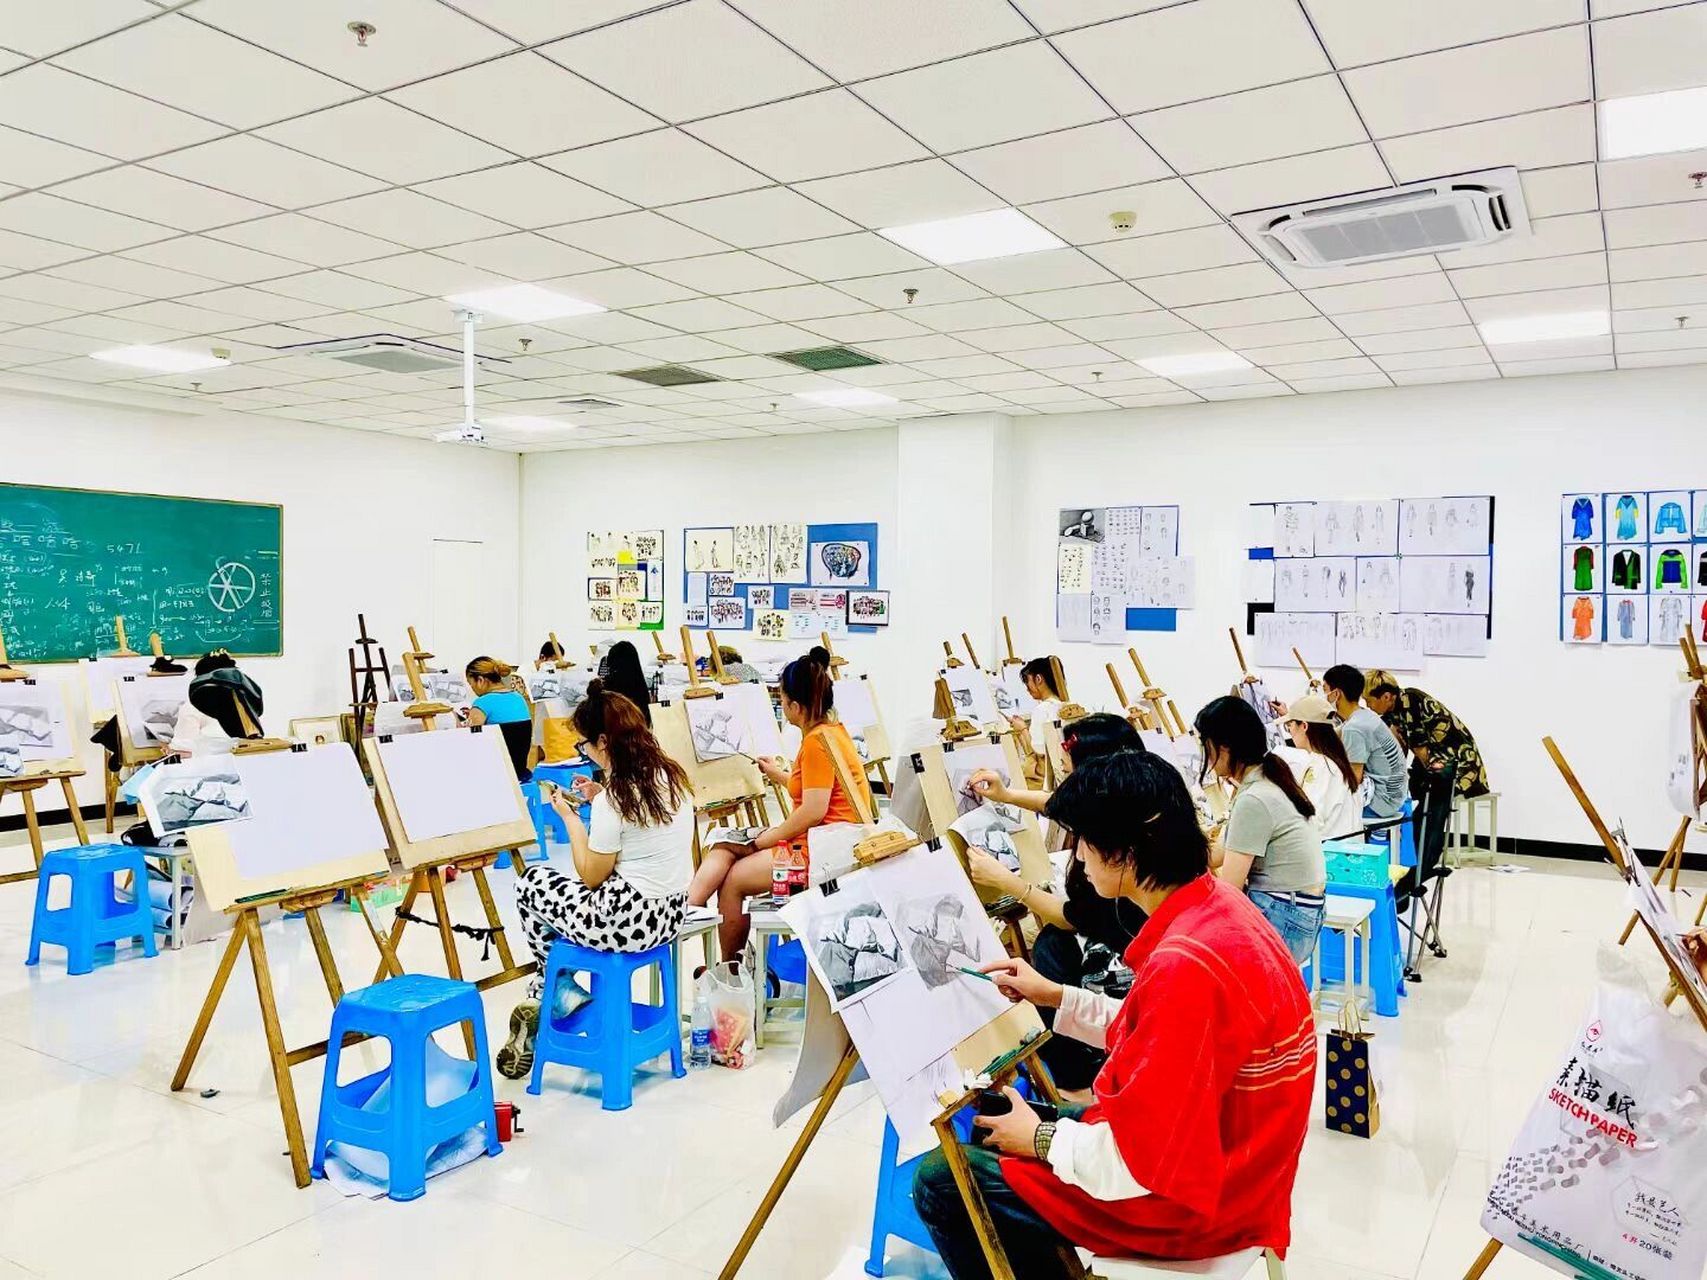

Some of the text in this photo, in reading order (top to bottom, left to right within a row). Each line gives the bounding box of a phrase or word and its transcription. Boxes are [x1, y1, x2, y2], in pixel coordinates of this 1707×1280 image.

[1548, 1088, 1638, 1148] SKETCH PAPER
[1556, 1056, 1636, 1130] 素描纸
